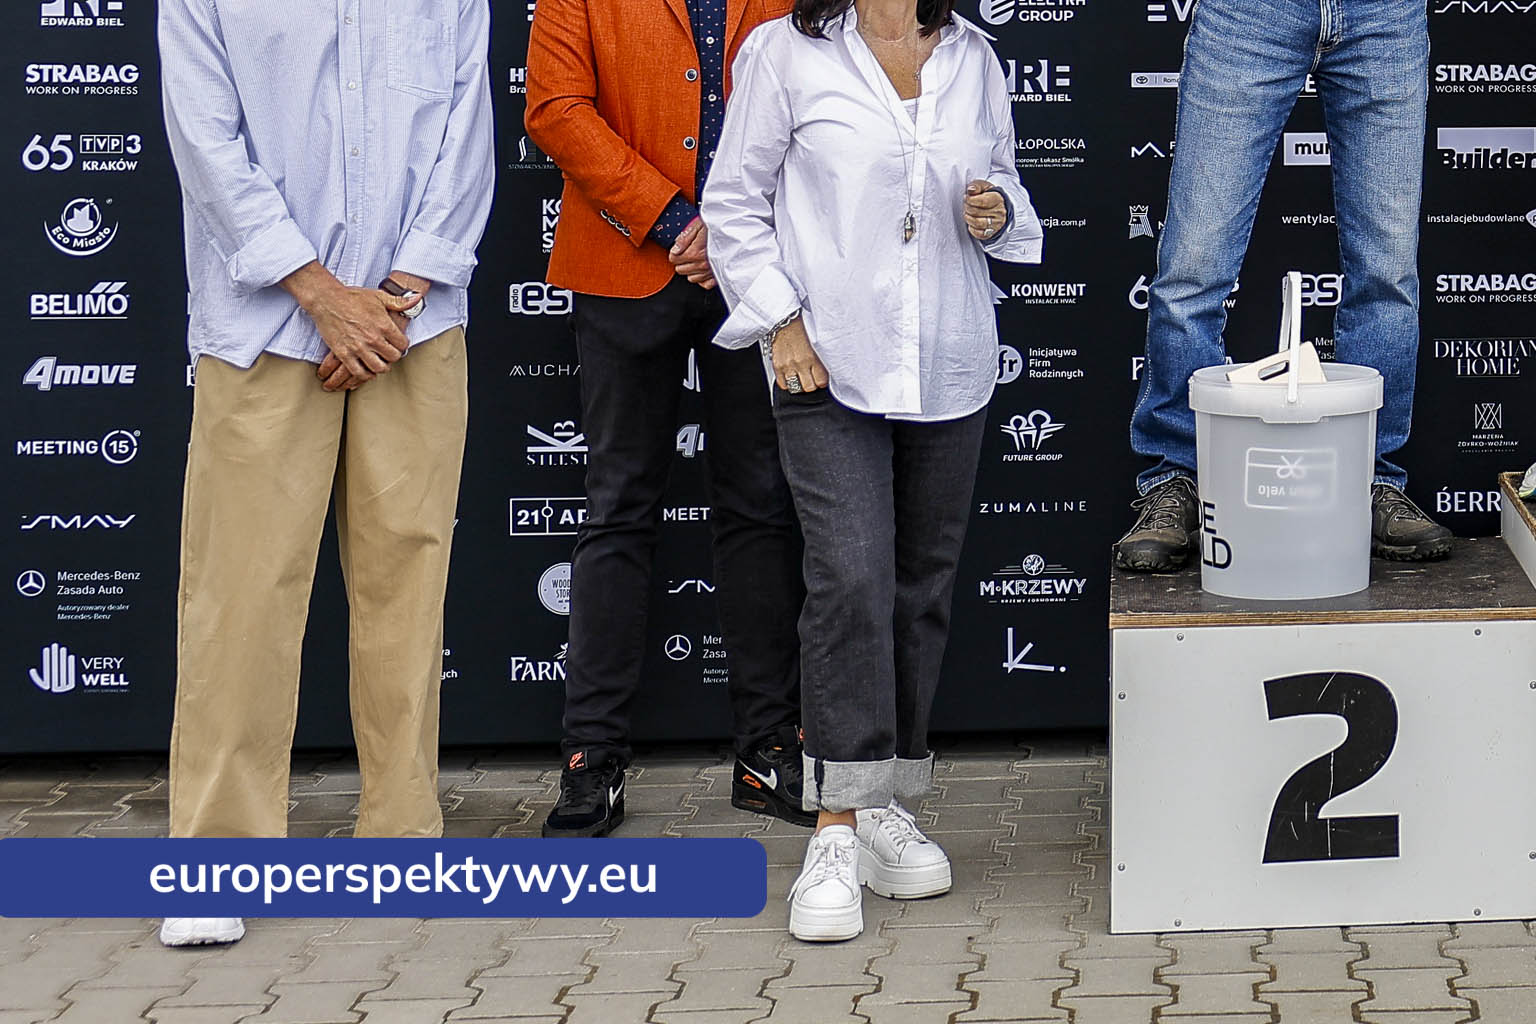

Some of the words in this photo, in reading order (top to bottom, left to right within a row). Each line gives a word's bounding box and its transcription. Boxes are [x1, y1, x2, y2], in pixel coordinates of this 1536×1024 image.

[40, 17, 94, 26] EDWARD
[96, 17, 125, 27] BIEL
[1018, 9, 1074, 22] GROUP
[25, 63, 140, 84] STRABAG
[25, 85, 59, 95] WORK
[61, 86, 80, 95] ON
[84, 86, 138, 95] PROGRESS
[1434, 84, 1466, 93] WORK
[1467, 84, 1485, 93] ON
[1045, 93, 1072, 102] BIEL
[22, 133, 74, 171] 65
[82, 157, 138, 171] KRAKÓW
[72, 225, 112, 248] Miasto
[1011, 283, 1087, 297] KONWENT
[30, 293, 129, 315] BELIMO
[1435, 294, 1467, 304] WORK
[1468, 294, 1486, 303] ON
[1029, 347, 1077, 359] Inicjatywa
[1029, 359, 1051, 368] Firm
[1457, 357, 1521, 376] HOME
[1029, 368, 1084, 380] Rodzinnych
[16, 440, 99, 455] MEETING
[108, 439, 129, 454] 15
[1002, 453, 1034, 462] FUTURE
[1035, 453, 1063, 461] GROUP
[517, 509, 540, 526] 21
[662, 506, 711, 521] MEET
[57, 570, 141, 581] Mercedes-Benz
[56, 585, 96, 596] Zasada
[97, 585, 124, 595] Auto
[81, 656, 124, 670] VERY
[81, 673, 130, 686] WELL
[1261, 671, 1400, 865] 2
